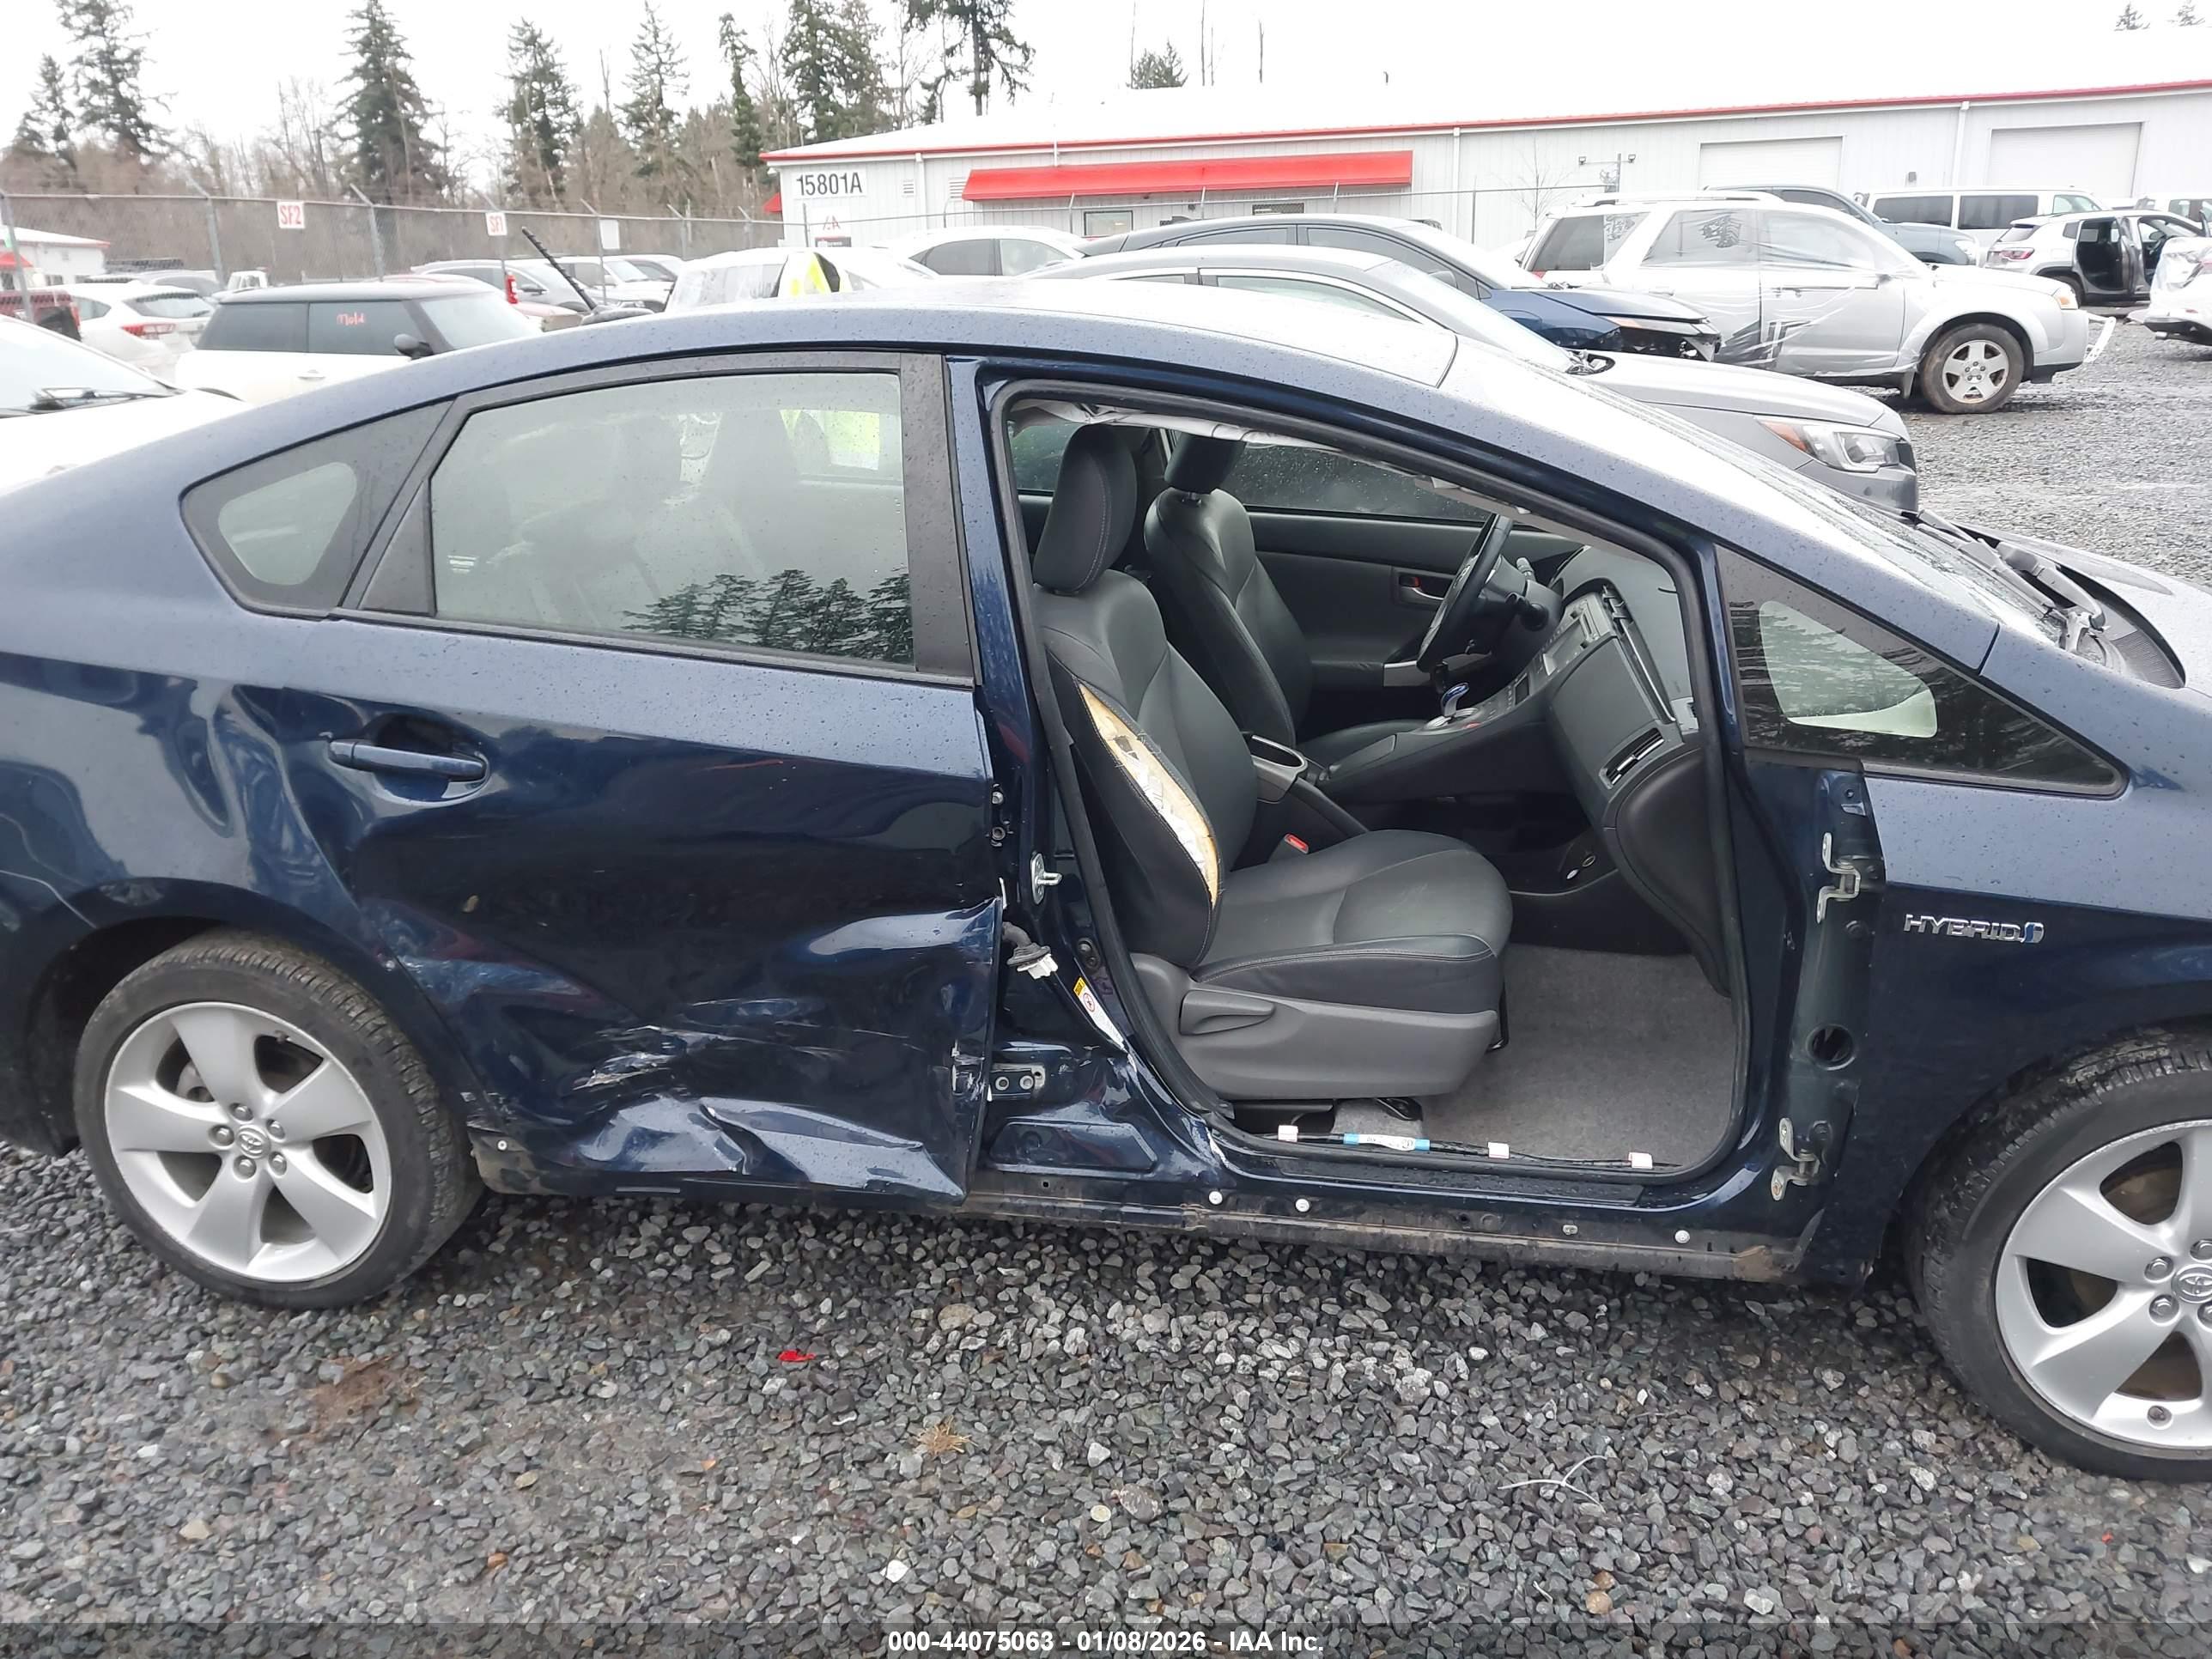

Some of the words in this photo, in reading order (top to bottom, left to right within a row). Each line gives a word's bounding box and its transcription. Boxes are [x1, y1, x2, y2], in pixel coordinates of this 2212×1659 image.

[796, 172, 863, 197] 15801A
[279, 204, 302, 226] SF2
[1903, 914, 2021, 942] HYBRID
